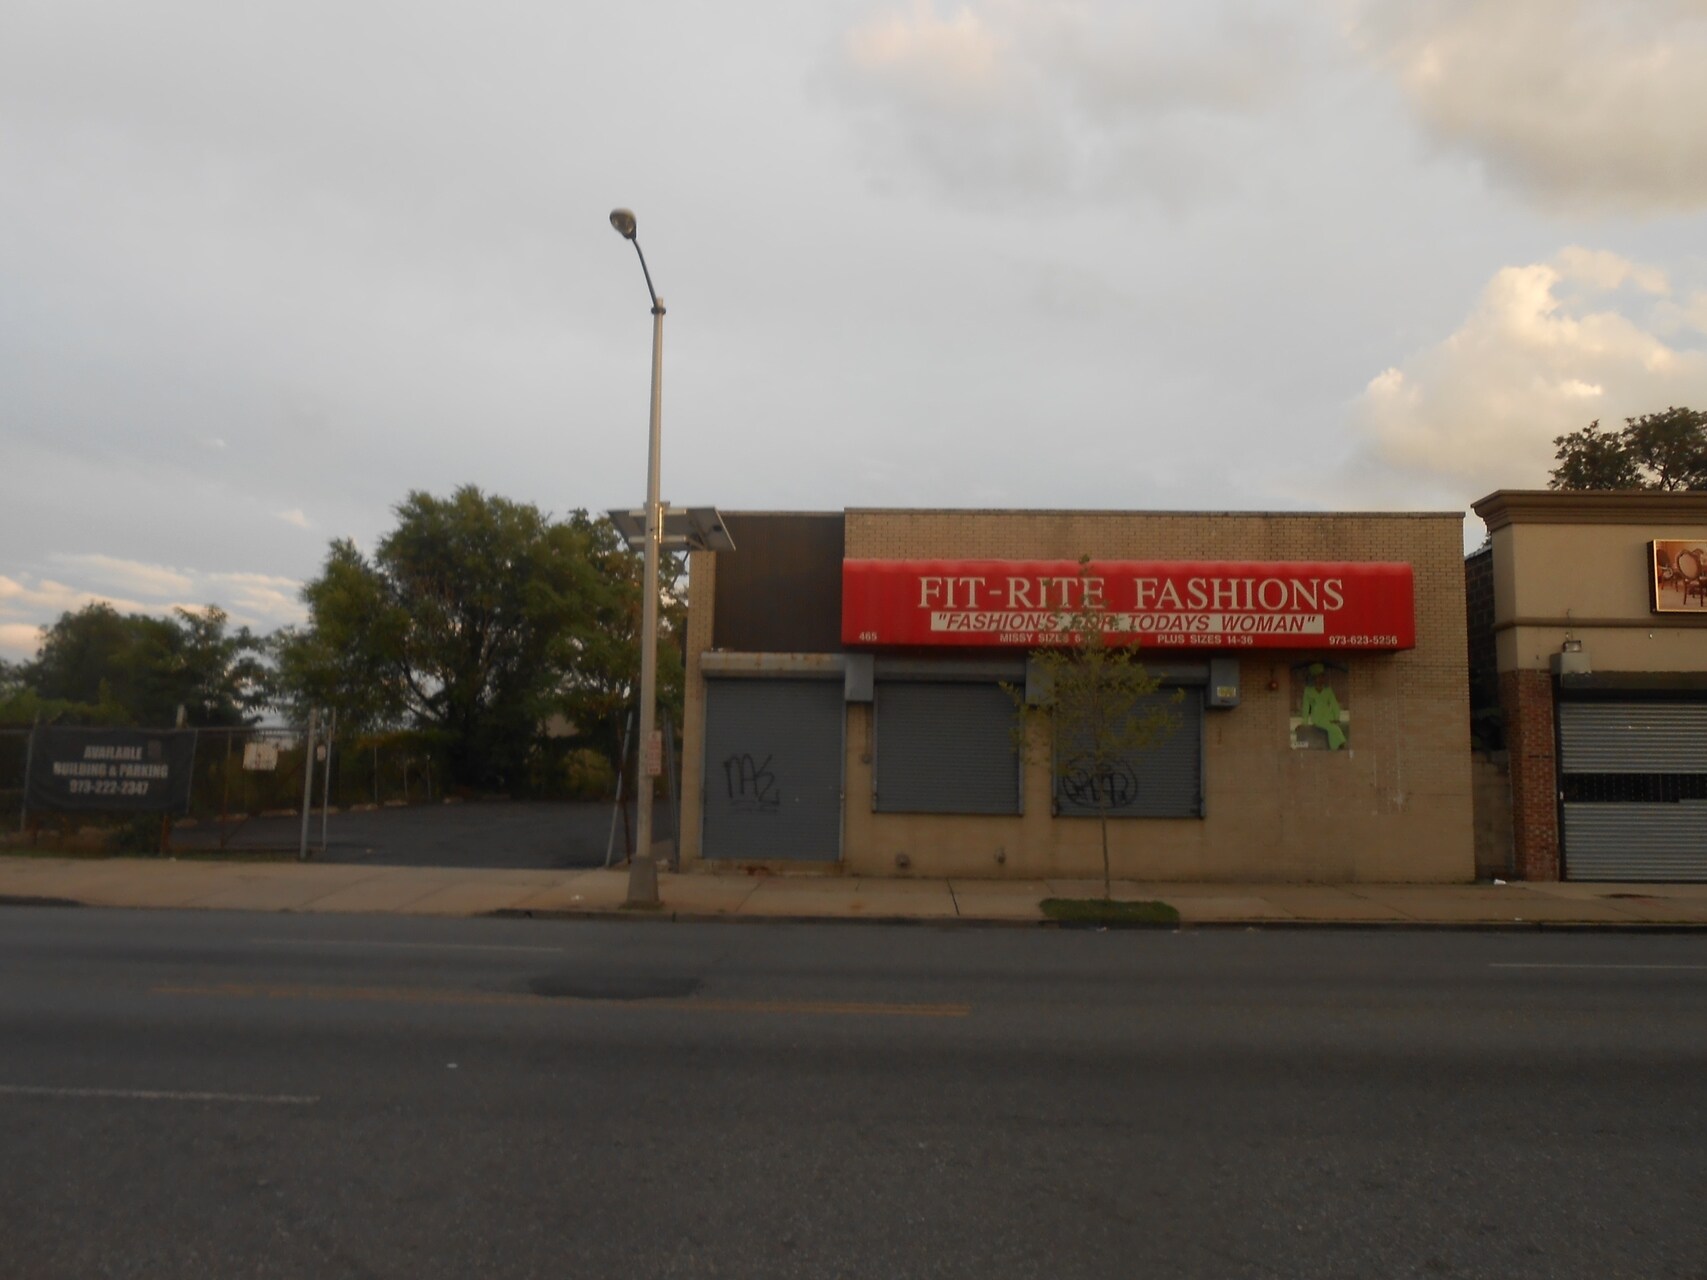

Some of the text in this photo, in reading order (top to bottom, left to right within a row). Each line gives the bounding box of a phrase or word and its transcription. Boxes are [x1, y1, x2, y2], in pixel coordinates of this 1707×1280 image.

[918, 576, 1345, 611] FIT-RITE FASHIONS
[1128, 614, 1210, 632] TODAYS
[1221, 615, 1317, 632] WOMAN"
[1000, 633, 1033, 643] MISSY
[1157, 634, 1254, 645] PLUS SIZES 14-36
[1328, 635, 1398, 646] 973-623-5256
[83, 745, 143, 760] AVAILABLE
[53, 762, 107, 777] BUILDING
[119, 764, 169, 778] PARKING
